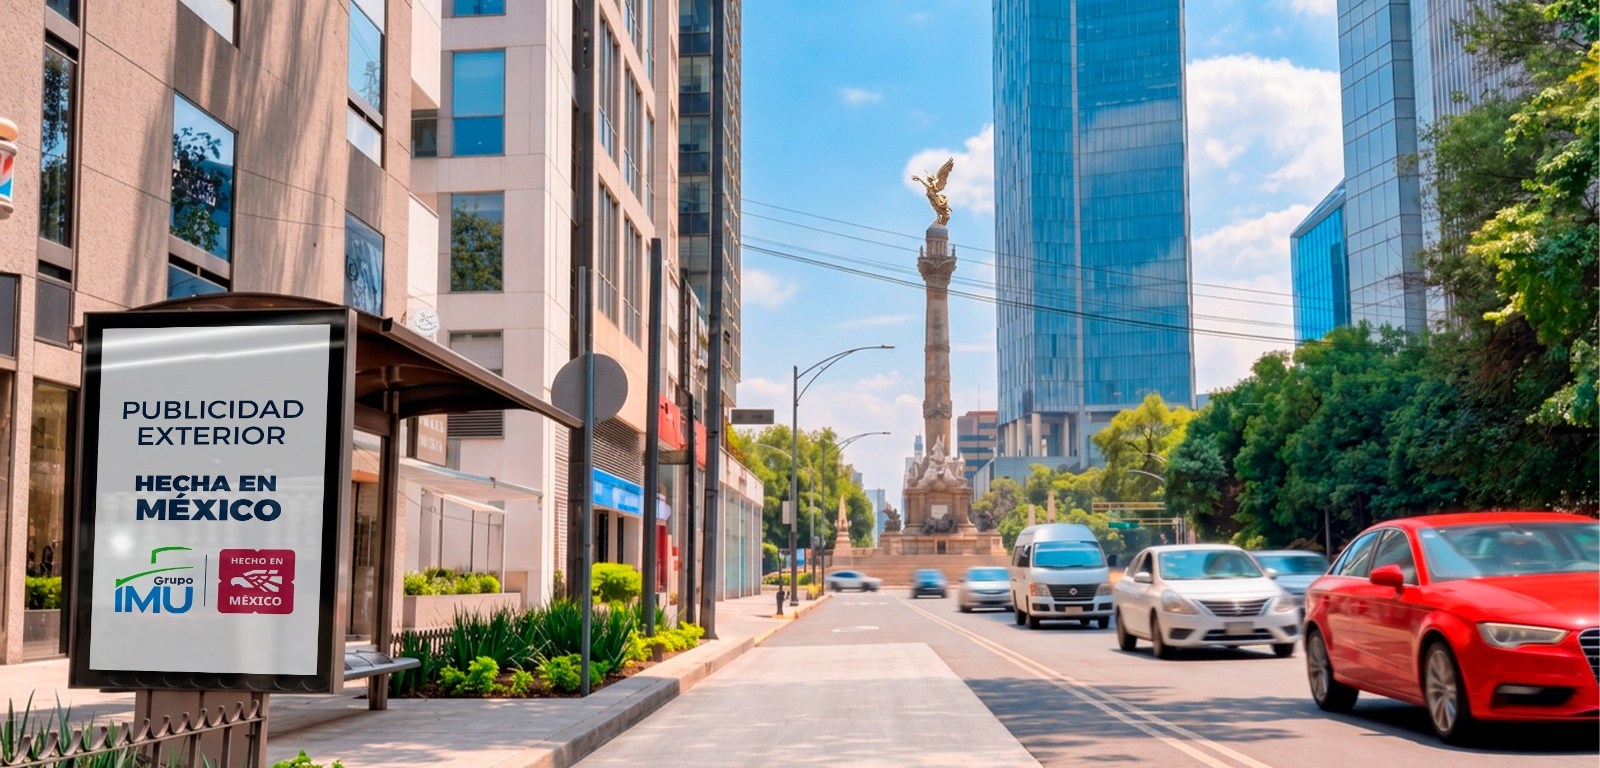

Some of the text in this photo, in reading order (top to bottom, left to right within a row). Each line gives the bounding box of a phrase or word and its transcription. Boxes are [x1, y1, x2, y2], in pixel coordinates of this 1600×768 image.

[122, 399, 304, 420] PUBLICIDAD
[137, 425, 286, 446] EXTERIOR
[135, 475, 277, 492] HECHA EN
[136, 493, 282, 522] MÉXICO
[231, 557, 284, 565] HECHO EN
[153, 576, 194, 587] Grupo
[114, 585, 194, 614] IMU
[229, 594, 282, 606] MÉXICO
